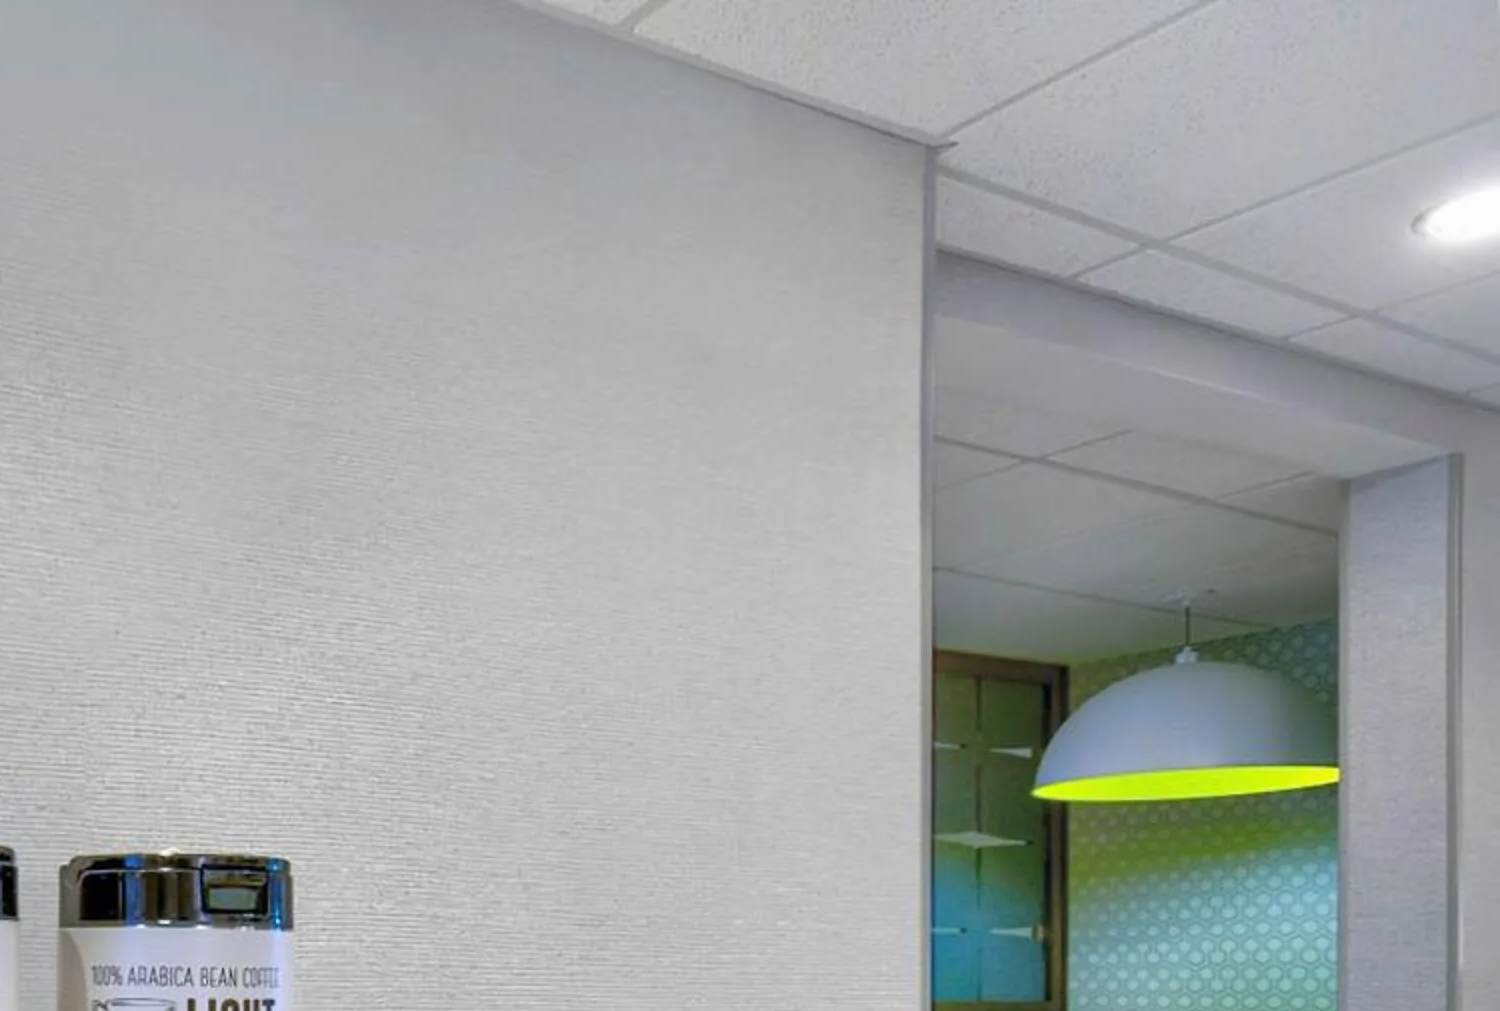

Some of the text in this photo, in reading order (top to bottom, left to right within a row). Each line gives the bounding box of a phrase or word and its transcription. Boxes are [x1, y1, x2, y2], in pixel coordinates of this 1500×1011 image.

[91, 966, 279, 988] 100% ARABICA BEAN COFFEE
